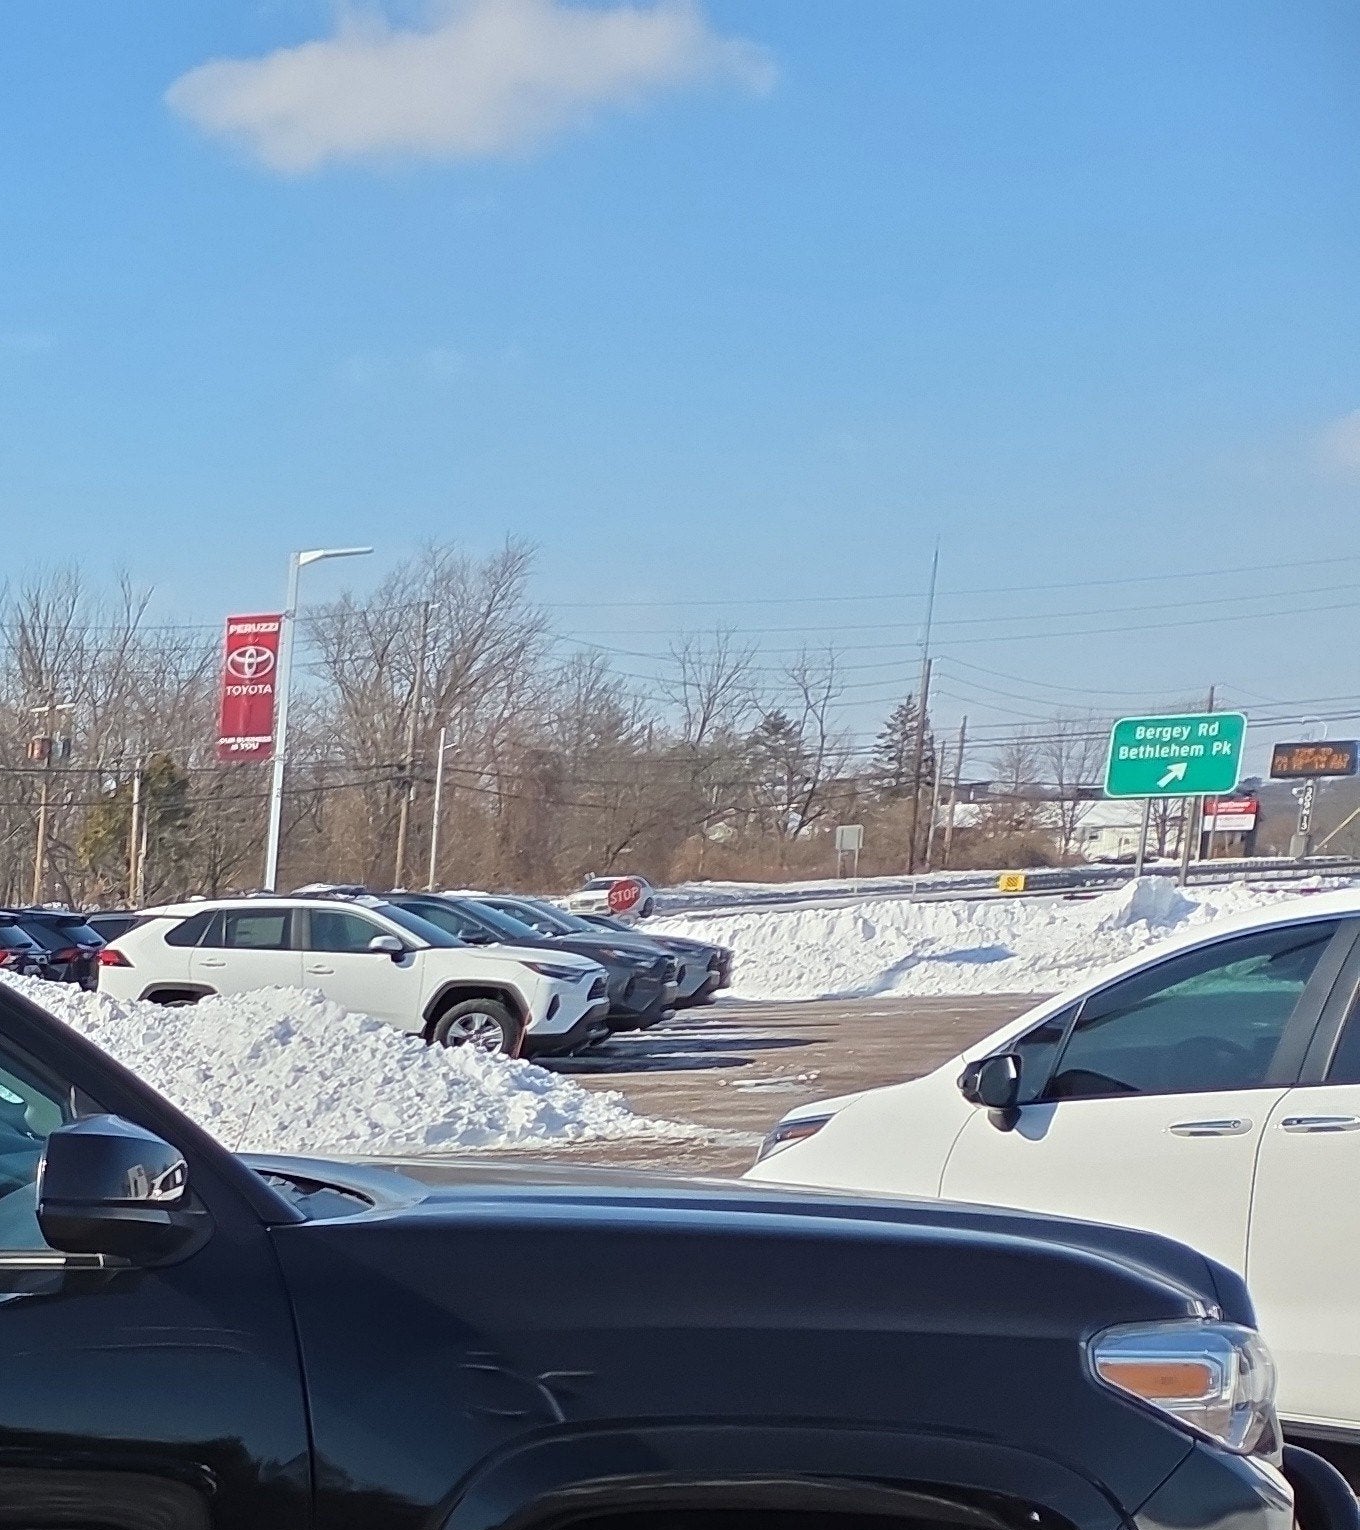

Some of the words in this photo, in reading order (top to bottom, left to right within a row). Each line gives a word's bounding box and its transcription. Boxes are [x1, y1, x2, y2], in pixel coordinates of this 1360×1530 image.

[229, 622, 279, 635] PERUZZI
[226, 684, 273, 696] TOYOTA
[1135, 725, 1191, 742] Bergey
[1197, 721, 1220, 737] Rd
[1118, 743, 1205, 760] Bethlehem
[1211, 740, 1233, 756] Pk
[610, 886, 639, 905] STOP
